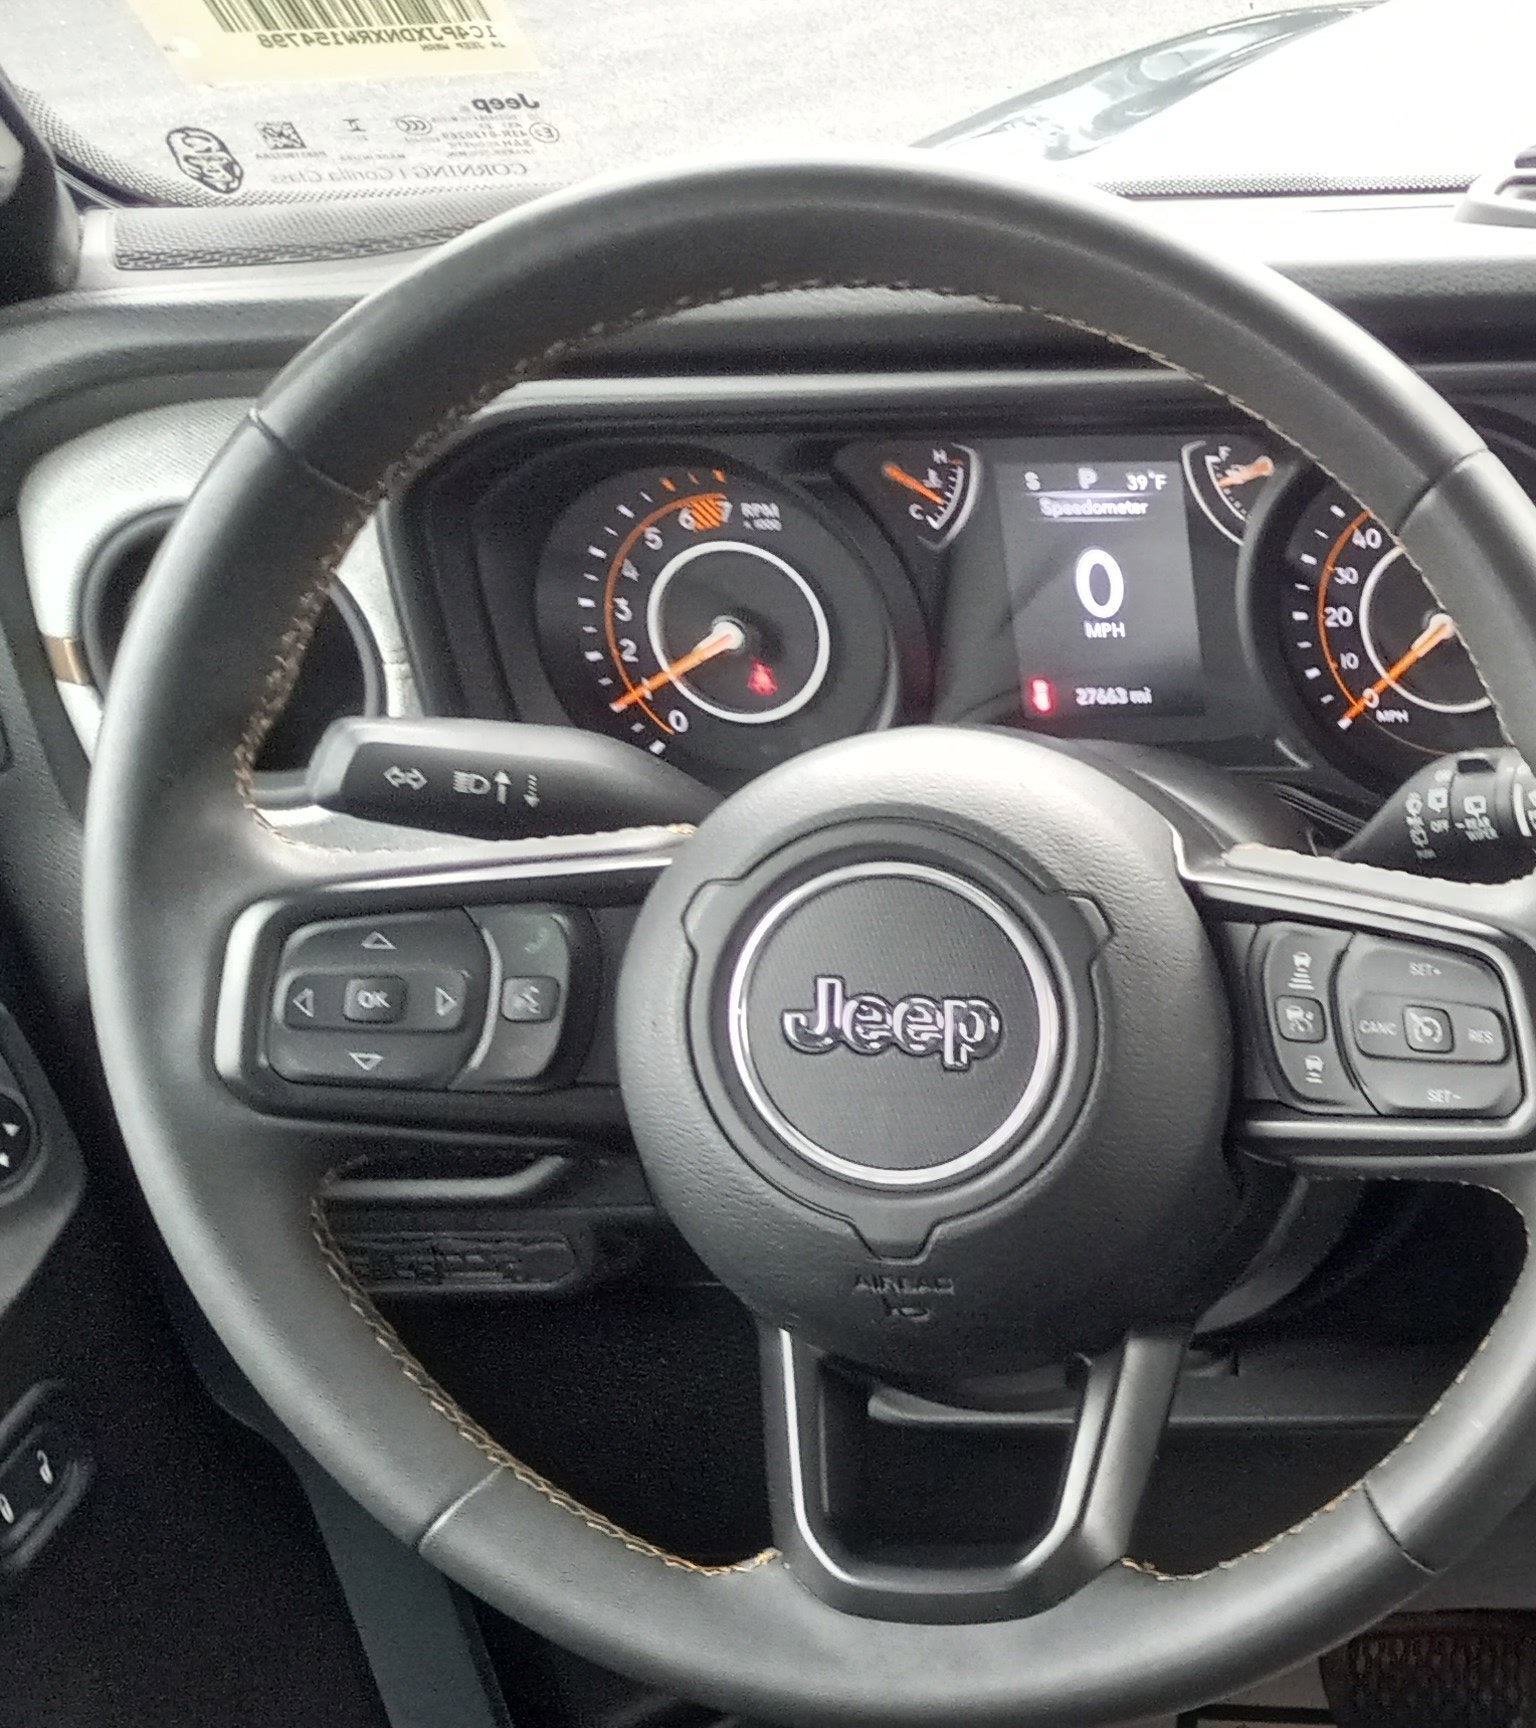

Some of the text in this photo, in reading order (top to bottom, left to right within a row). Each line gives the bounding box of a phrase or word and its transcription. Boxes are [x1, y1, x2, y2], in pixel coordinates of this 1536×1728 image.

[1077, 467, 1098, 490] P
[908, 503, 925, 520] C
[1039, 497, 1149, 518] Speedometer
[644, 527, 664, 550] 5
[1352, 528, 1382, 549] 40
[620, 558, 641, 582] 4
[1332, 565, 1359, 585] 30
[1075, 548, 1124, 619] 0
[613, 598, 634, 622] 3
[1324, 607, 1354, 628] 20
[1084, 621, 1126, 639] MPH
[618, 638, 641, 663] 2
[1339, 651, 1360, 670] 10
[668, 709, 689, 733] 0
[1376, 709, 1409, 723] MPH
[782, 975, 1003, 1071] Jeep
